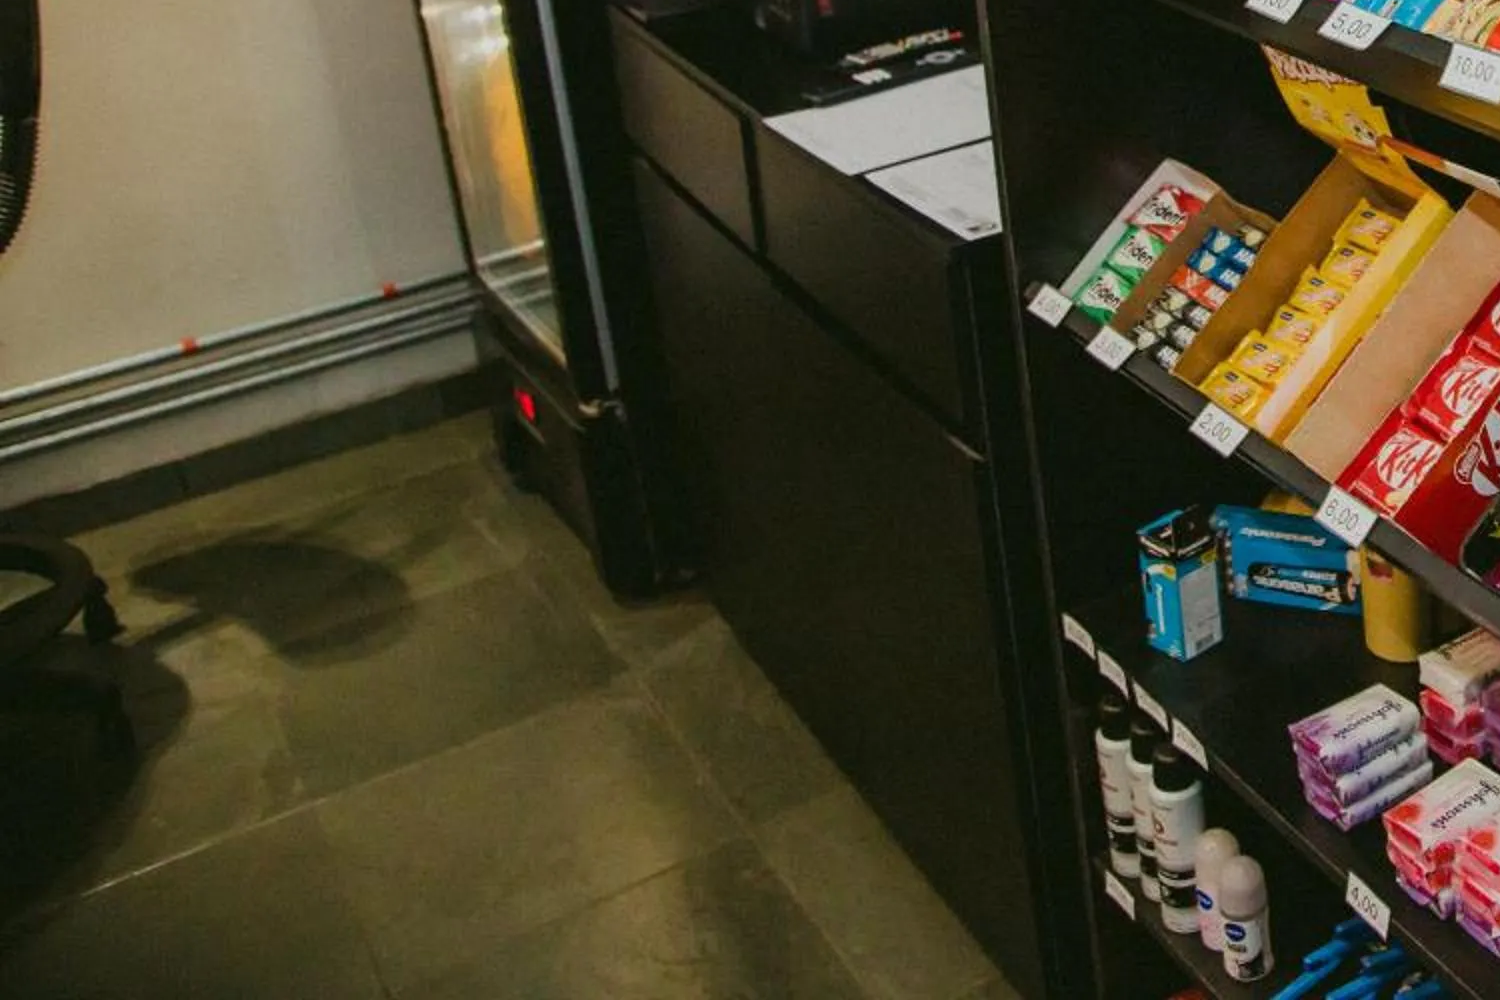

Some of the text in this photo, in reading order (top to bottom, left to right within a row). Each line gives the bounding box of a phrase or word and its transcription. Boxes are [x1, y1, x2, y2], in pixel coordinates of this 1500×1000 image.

[1331, 12, 1373, 40] 5,00
[1455, 55, 1496, 82] 10,00
[1200, 411, 1232, 444] 2,00
[1350, 885, 1380, 923] 4,00
